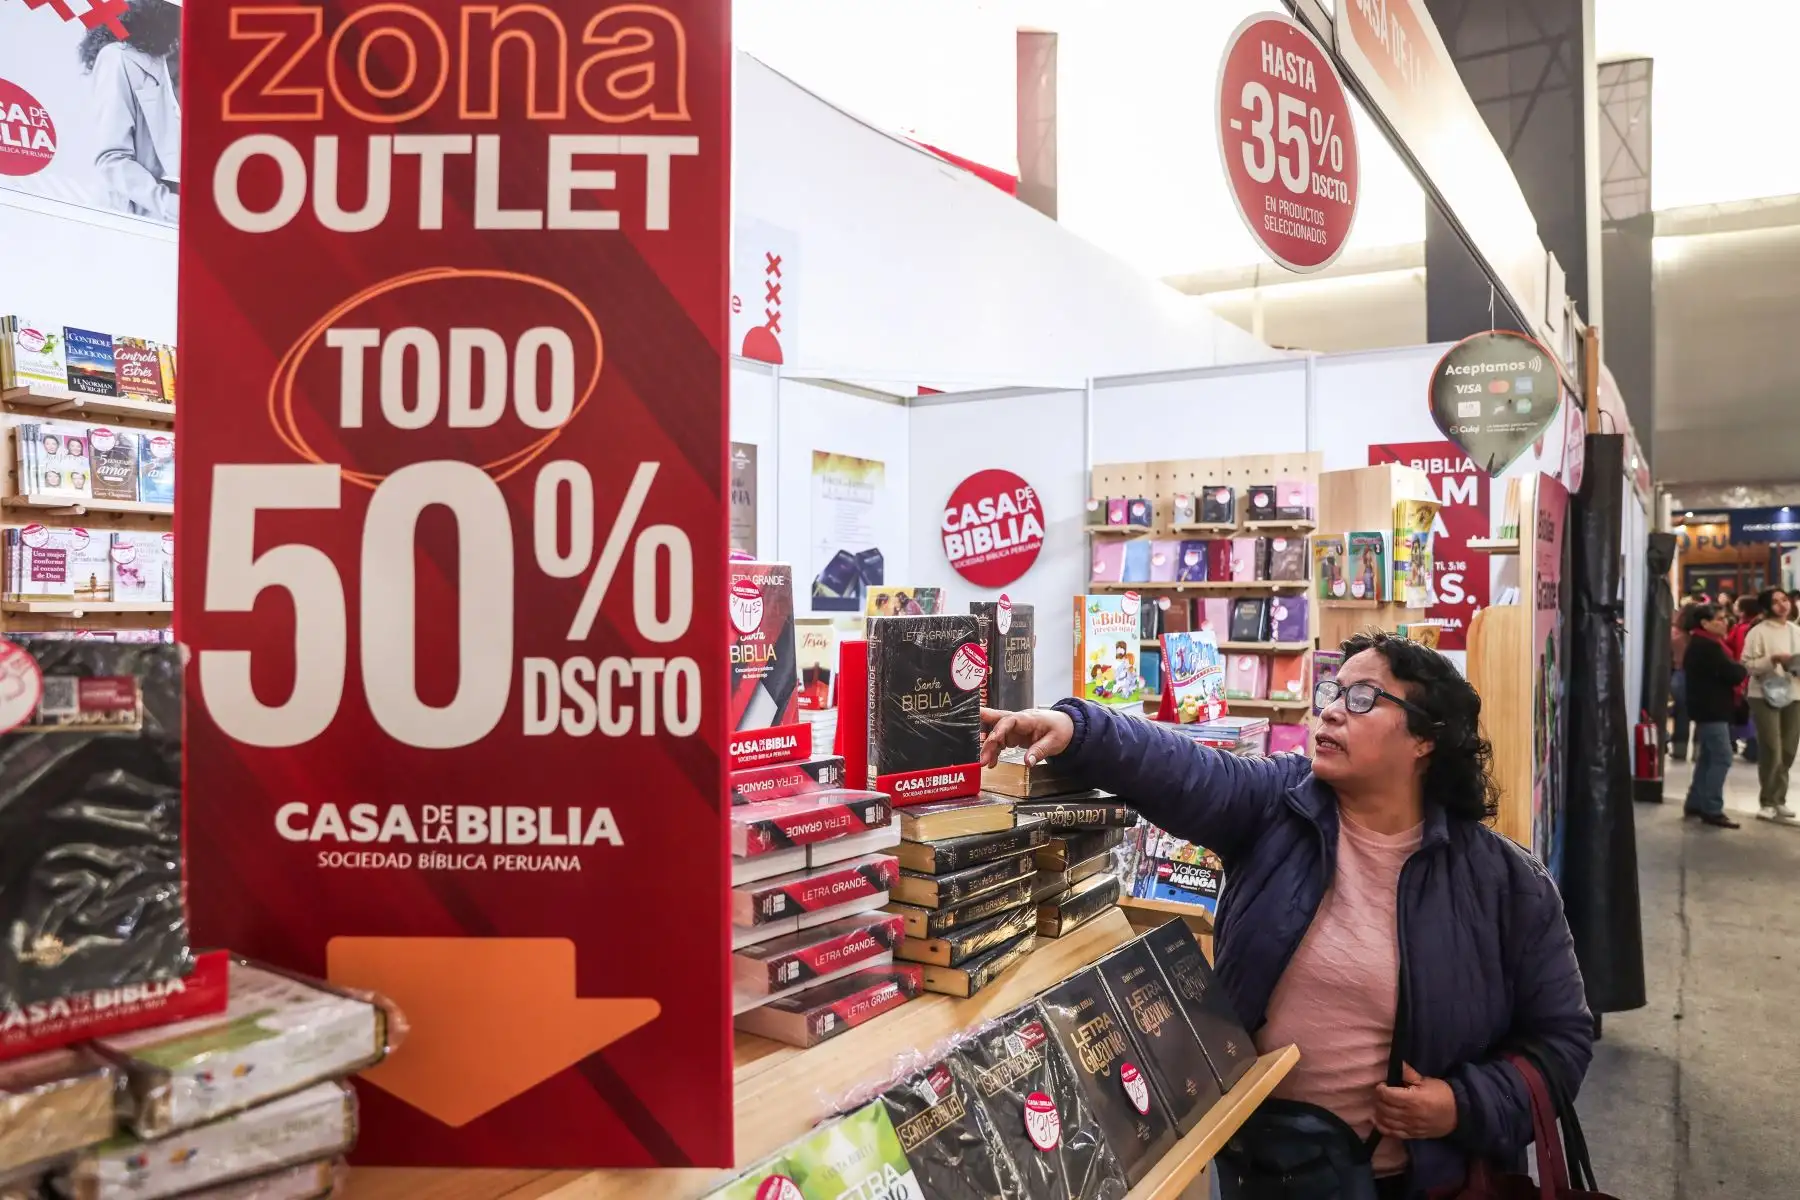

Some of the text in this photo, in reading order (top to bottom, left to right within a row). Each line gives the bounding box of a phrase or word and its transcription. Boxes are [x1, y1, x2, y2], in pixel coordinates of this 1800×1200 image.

[222, 3, 691, 122] zona
[1261, 41, 1317, 93] HASTA
[1230, 81, 1343, 194] -35%
[213, 133, 700, 233] OUTLET
[1312, 171, 1352, 206] DSCTO.
[1265, 195, 1325, 227] EN PRODUCTOS
[1264, 214, 1327, 246] SELECCIONADOS
[326, 326, 576, 429] TODO
[1445, 361, 1526, 377] Aceptamos
[1455, 383, 1482, 394] VISA
[97, 465, 130, 476] amor
[1411, 456, 1477, 474] BIBLIA
[941, 486, 1034, 533] CASA DE
[1018, 499, 1036, 514] LA
[944, 512, 1045, 562] BIBLIA
[752, 575, 784, 586] GRANDE
[199, 459, 694, 750] 50%
[928, 629, 963, 641] GRANDE
[1005, 636, 1031, 651] LETRA
[730, 643, 777, 664] BIBLIA
[523, 656, 702, 738] DSCTO
[914, 677, 942, 692] Santa
[902, 692, 952, 712] BIBLIA
[729, 739, 759, 756] CASA
[765, 735, 797, 751] BIBLIA
[737, 775, 804, 794] LETRA GRANDE
[895, 777, 925, 792] CASA
[932, 772, 966, 787] BIBLIA
[275, 802, 625, 846] CASA DE BIBLIA
[786, 814, 851, 838] LETRA GRANDE
[1078, 808, 1107, 825] Letra
[422, 824, 454, 843] LA
[317, 848, 581, 872] SOCIEDAD BÍBLICA PERUANA
[1173, 863, 1212, 879] Valores
[802, 875, 867, 902] LETRA GRANDE
[1169, 872, 1217, 889] MANGA
[815, 936, 876, 967] LETRA GRANDE
[847, 988, 899, 1019] LETRA GRANDE
[1125, 980, 1164, 1012] LETRA
[1133, 995, 1175, 1038] Gigante
[1070, 1012, 1115, 1049] LETRA
[1078, 1030, 1127, 1077] Gigante
